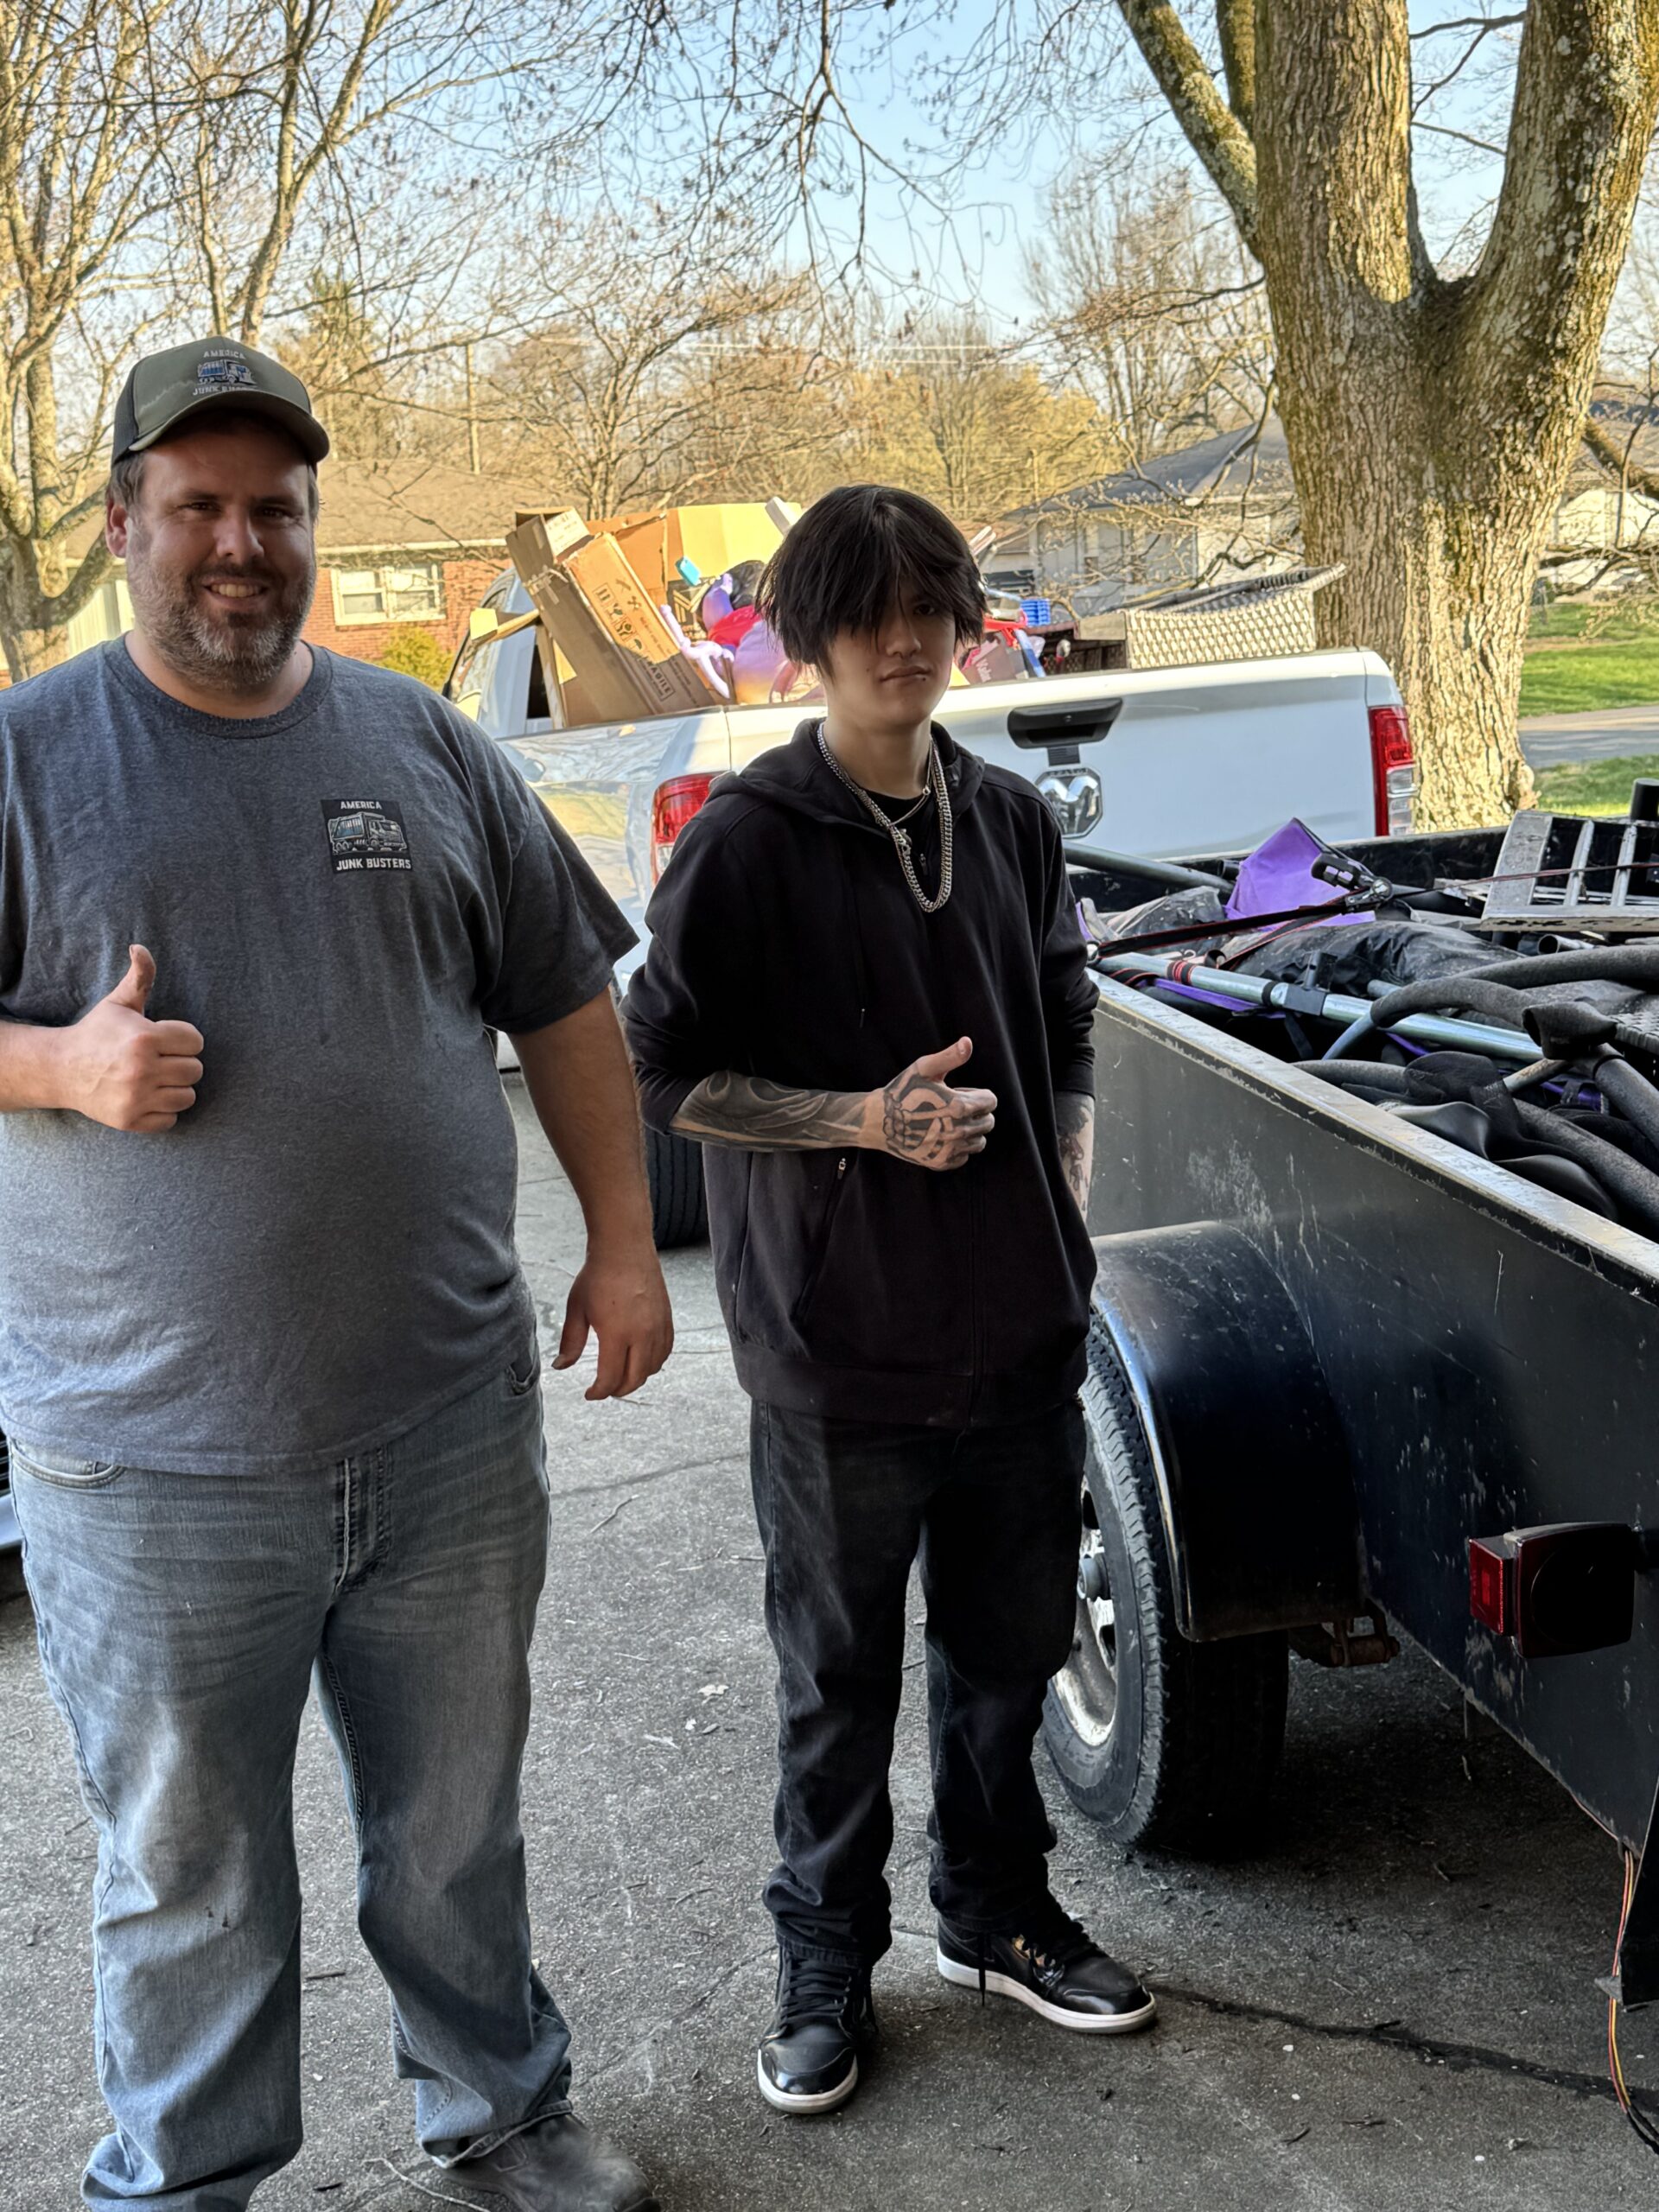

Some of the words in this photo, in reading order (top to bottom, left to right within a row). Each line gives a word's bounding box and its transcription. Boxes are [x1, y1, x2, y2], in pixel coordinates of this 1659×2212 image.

[203, 349, 246, 359] AMERICA
[193, 385, 219, 396] JUNK
[340, 800, 382, 810] AMERICA
[336, 858, 363, 871] JUNK
[365, 857, 412, 869] BUSTERS
